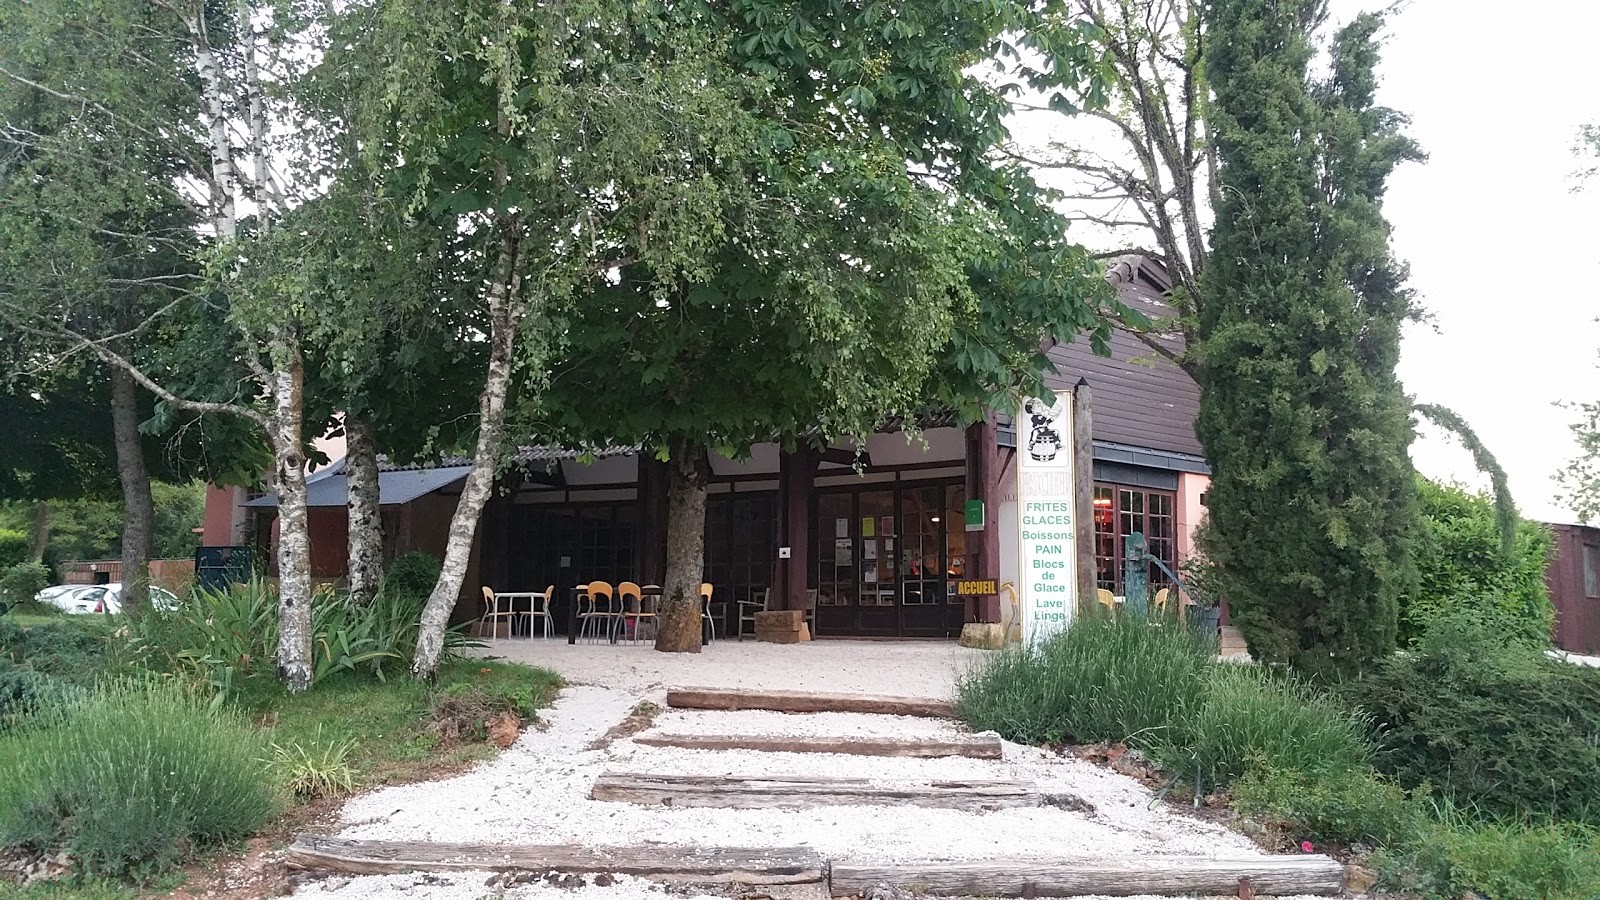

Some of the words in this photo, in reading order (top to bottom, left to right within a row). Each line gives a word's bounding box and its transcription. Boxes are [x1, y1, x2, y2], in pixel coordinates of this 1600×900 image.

[1026, 503, 1068, 512] FRITES
[1022, 515, 1071, 525] GLACES
[1022, 530, 1075, 540] Boissons
[1035, 545, 1062, 554] PAIN
[1033, 559, 1065, 569] Blocs
[1041, 571, 1055, 580] de
[958, 581, 996, 595] ACCUEIL
[1034, 583, 1066, 592] Glace
[1036, 598, 1063, 608] Lave
[1034, 610, 1065, 623] Linge
